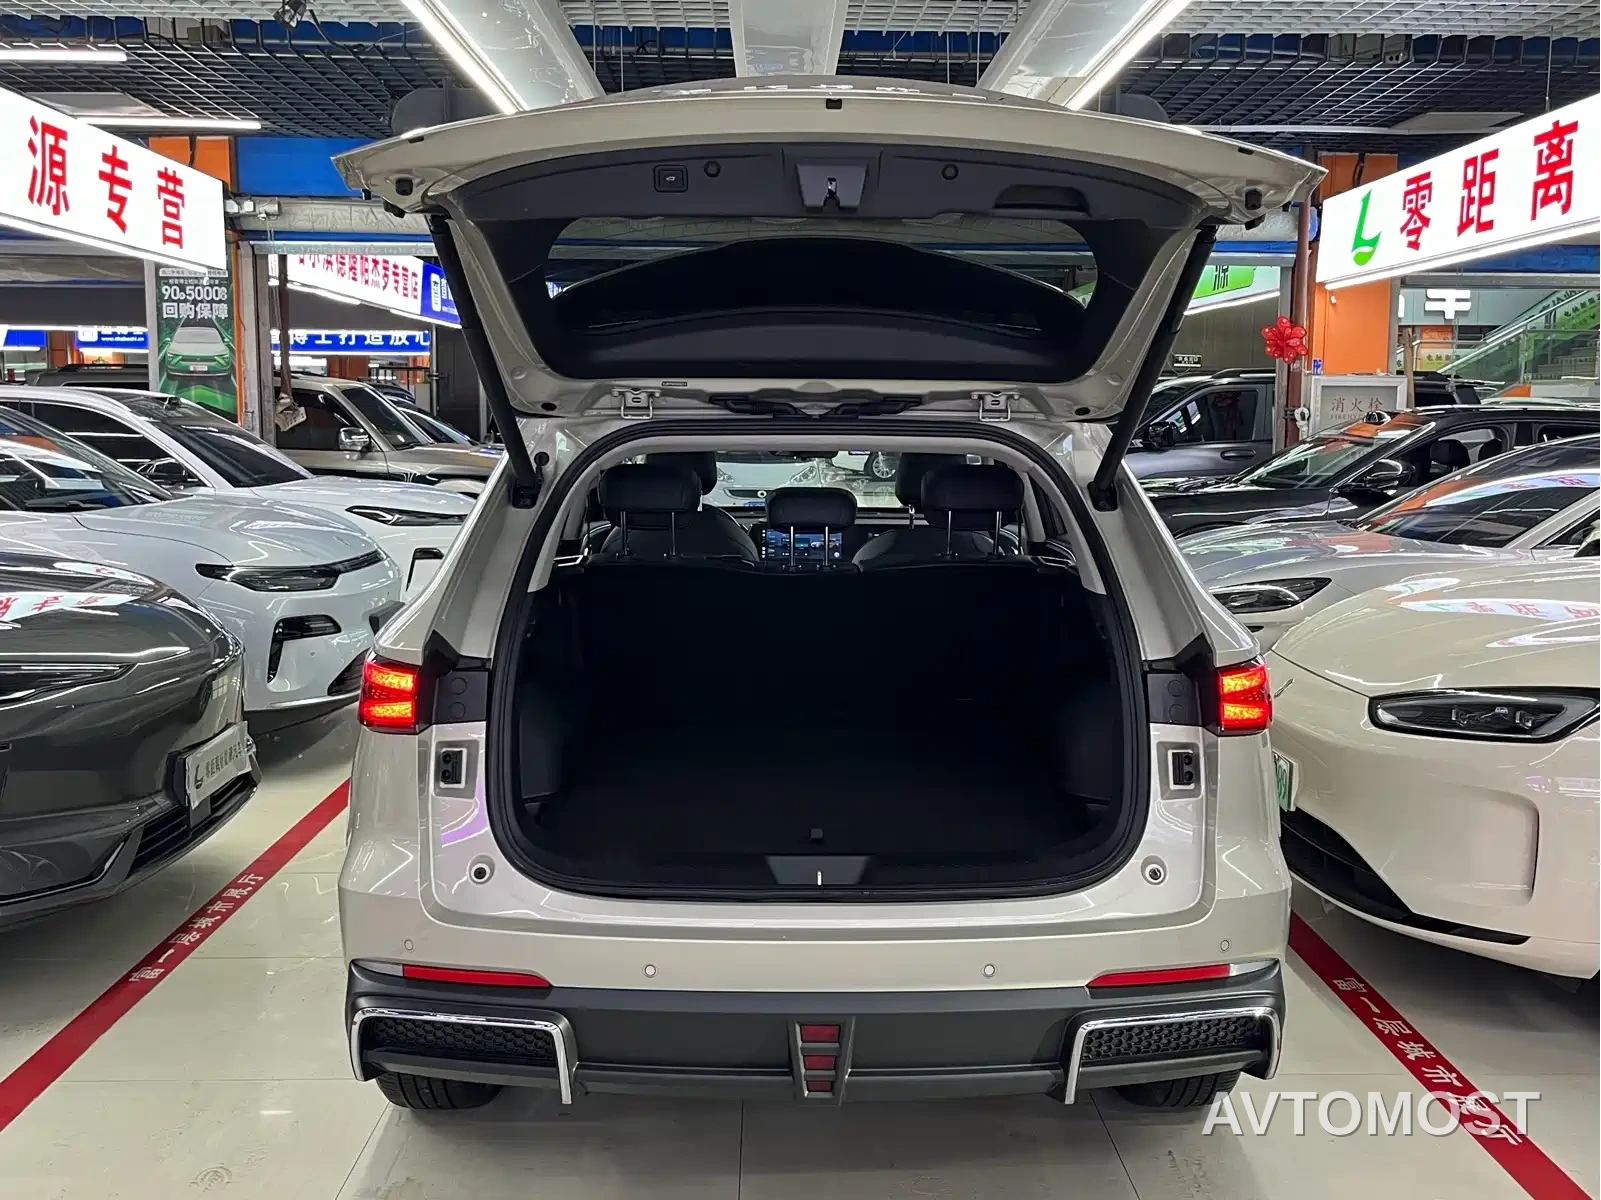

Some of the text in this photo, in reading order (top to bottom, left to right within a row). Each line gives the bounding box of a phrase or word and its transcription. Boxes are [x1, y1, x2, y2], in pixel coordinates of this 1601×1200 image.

[27, 114, 186, 249] 源专营
[1400, 119, 1579, 251] 零距离
[162, 302, 229, 320] 回购保障
[1330, 396, 1384, 413] 消火栓
